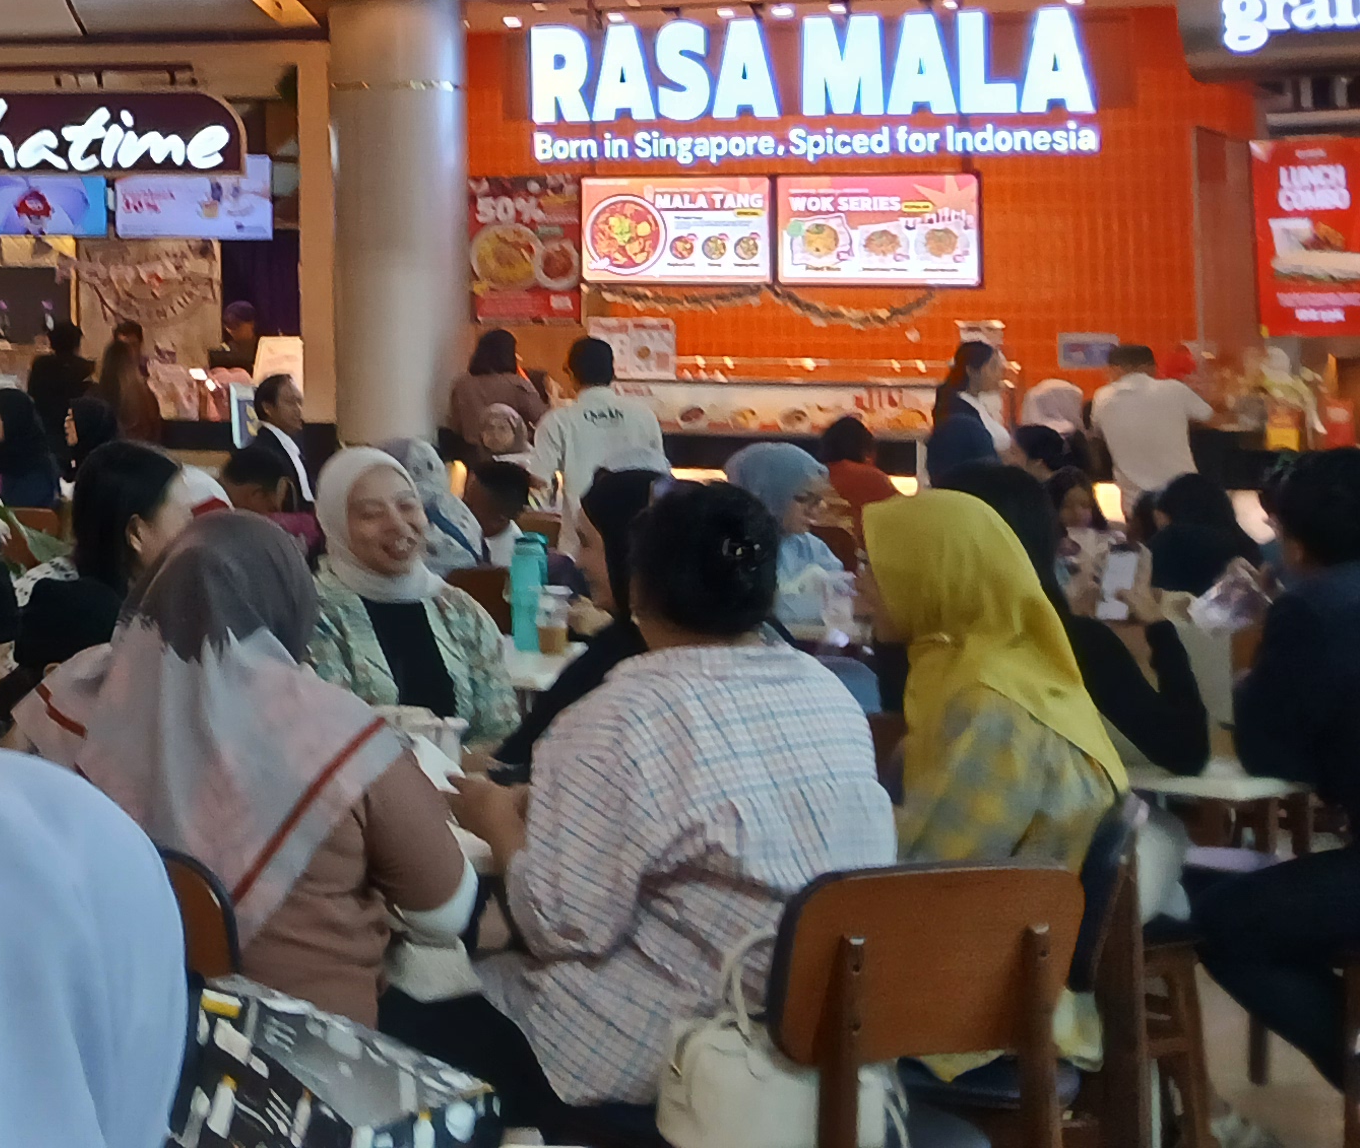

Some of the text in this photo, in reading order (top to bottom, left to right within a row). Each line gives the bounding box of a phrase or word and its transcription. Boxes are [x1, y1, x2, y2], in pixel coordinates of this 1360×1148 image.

[529, 7, 1096, 124] RASA MALA
[533, 120, 1098, 165] Born in Singapore, Spiced for Indonesia
[1279, 164, 1347, 188] LUNCH
[655, 193, 763, 209] MALA TANG
[789, 196, 901, 212] WOK SERIES
